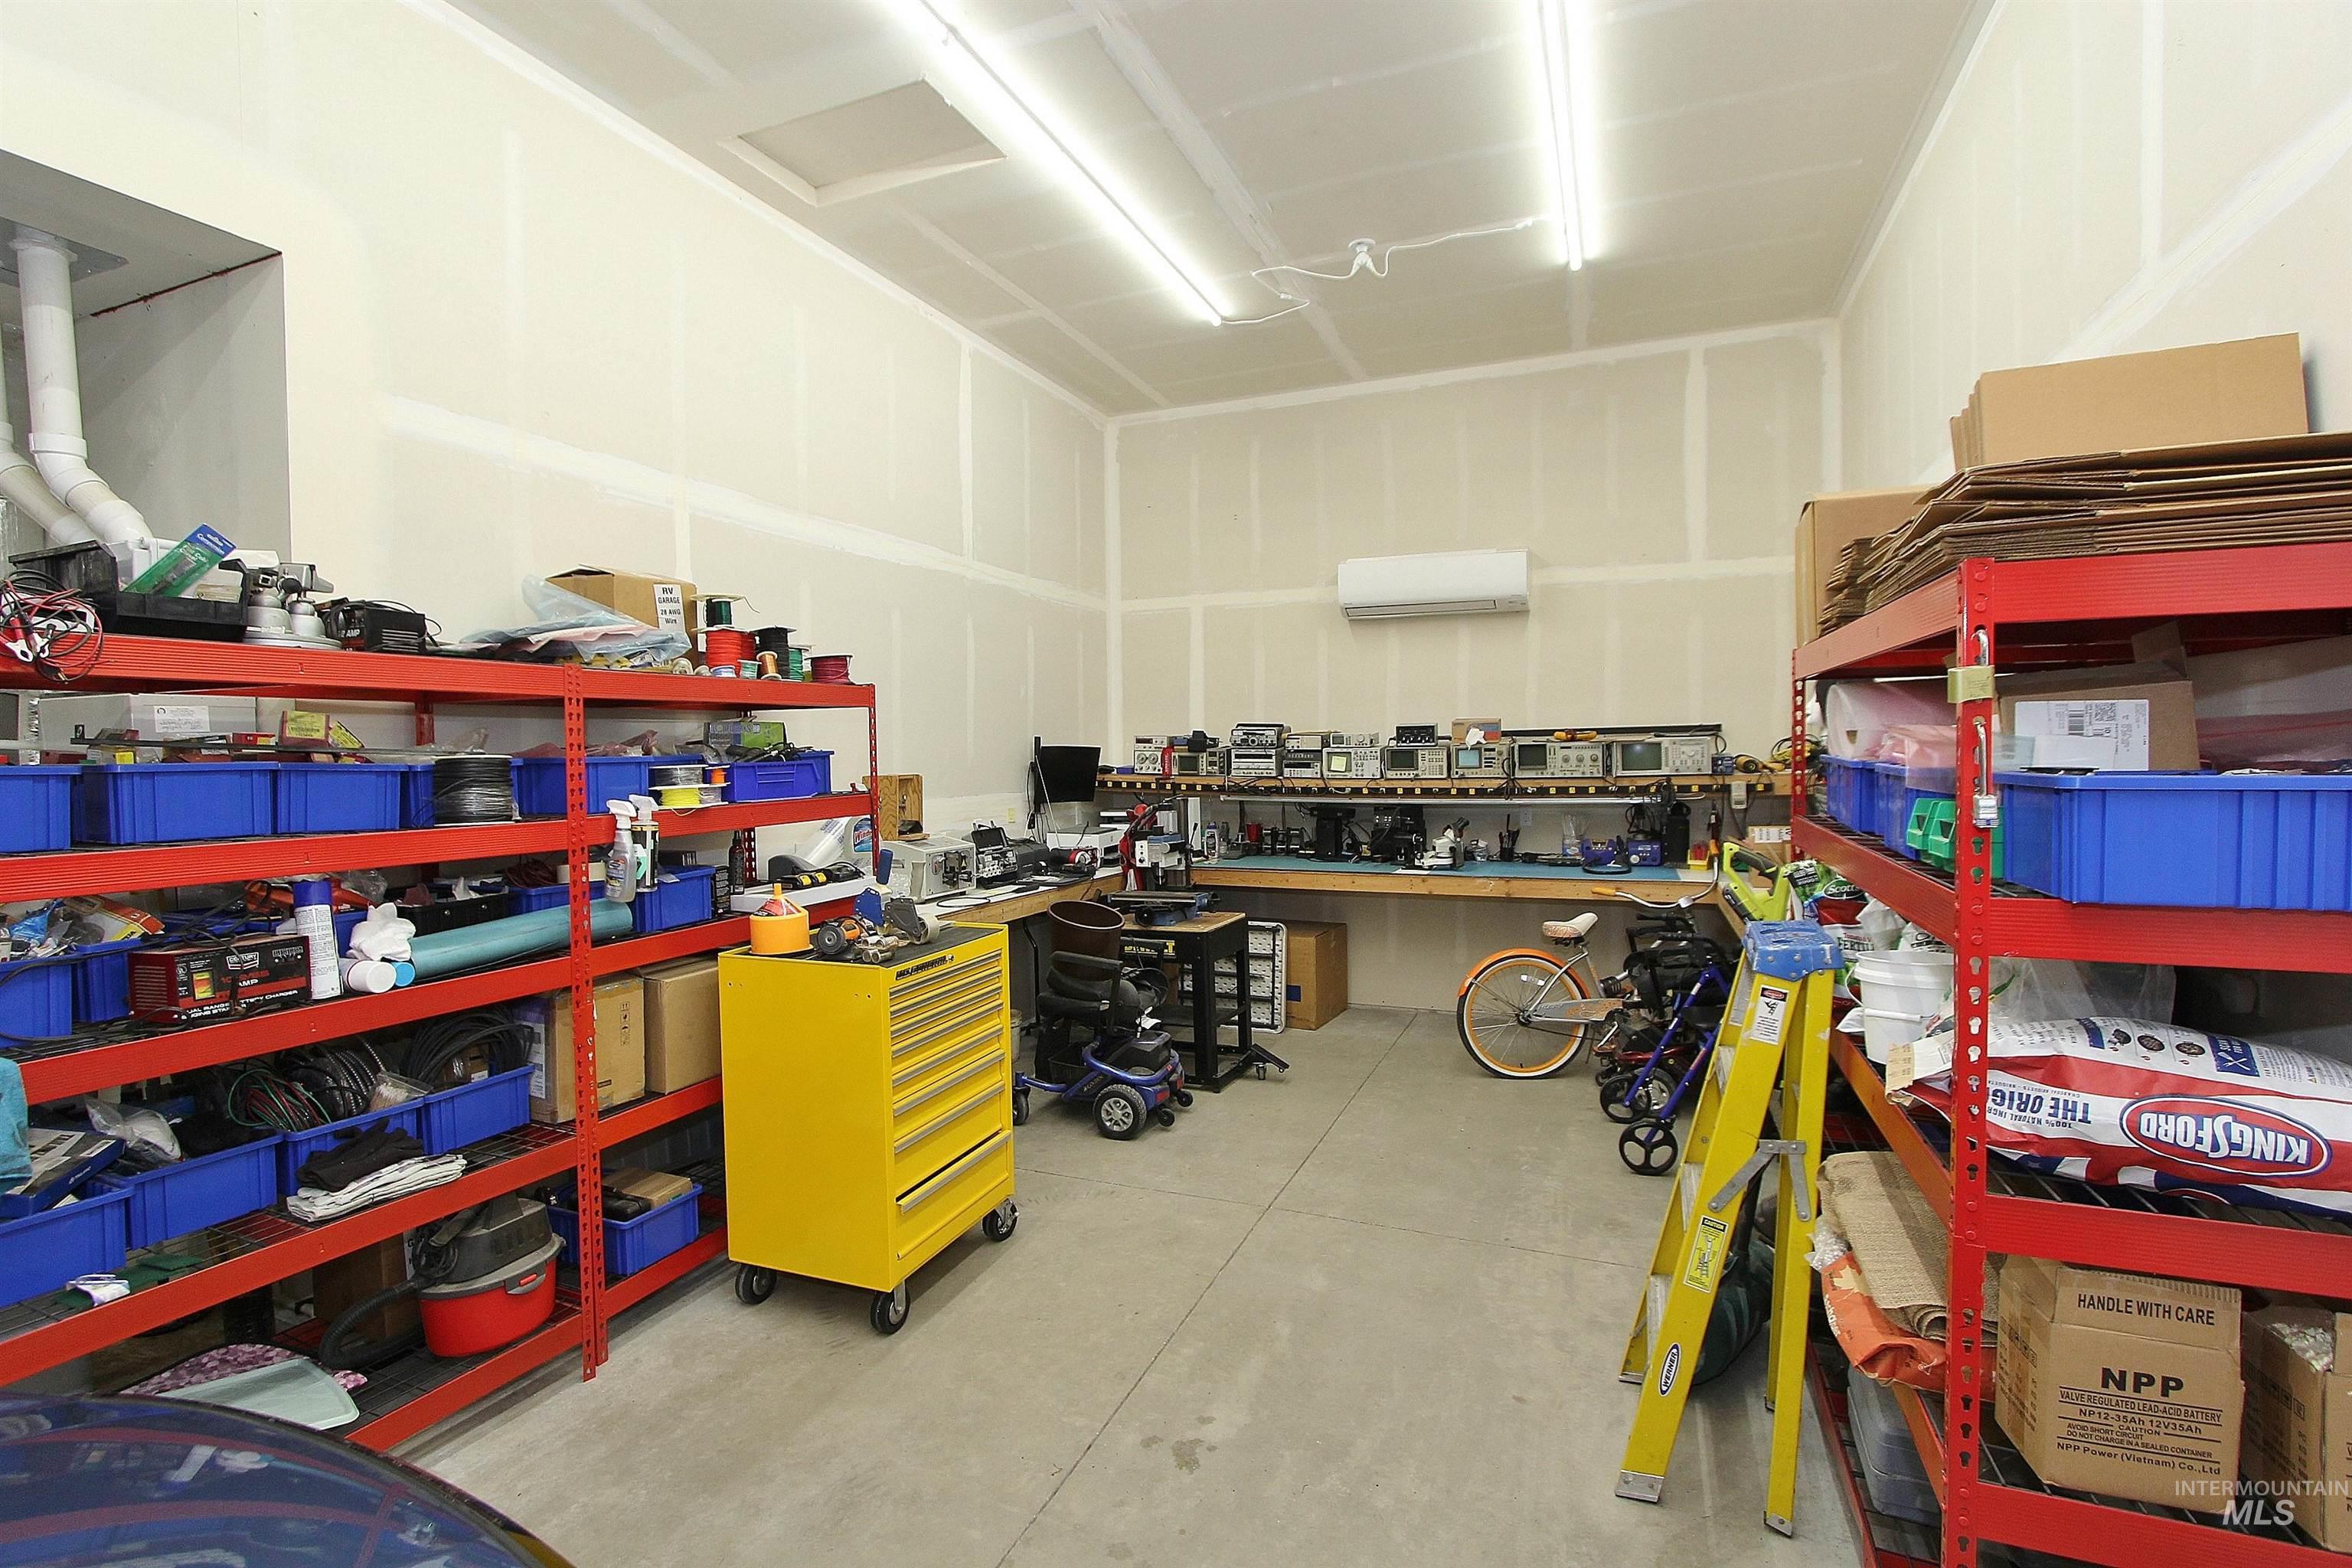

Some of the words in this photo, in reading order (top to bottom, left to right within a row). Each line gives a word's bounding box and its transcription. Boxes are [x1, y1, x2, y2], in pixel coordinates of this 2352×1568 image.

[662, 586, 673, 595] RV
[345, 629, 361, 637] AMP
[266, 990, 299, 1000] CHARGER
[2010, 1113, 2043, 1125] NATURAL
[2045, 1119, 2073, 1129] 100%
[2047, 1096, 2092, 1125] THE
[2140, 1112, 2310, 1165] KINGSFORD
[2077, 1292, 2134, 1315] HANDLE
[2136, 1300, 2172, 1320] WITH
[2175, 1305, 2216, 1326] CARE
[1662, 1351, 1678, 1387] WERNER
[2100, 1367, 2184, 1398] NPP
[2060, 1390, 2086, 1403] VALVE
[2086, 1393, 2135, 1412] REGULATED
[2137, 1402, 2183, 1417] LEAD-ACID
[2183, 1410, 2222, 1423] BATTERY
[2066, 1422, 2089, 1432] AVOID
[2089, 1426, 2115, 1436] SHORT
[2115, 1429, 2145, 1441] CIRCUIT
[2079, 1407, 2145, 1426] NP12-35Ah
[2148, 1419, 2203, 1435] 12V35Ah
[2118, 1424, 2161, 1436] CAUTION
[2066, 1429, 2078, 1438] DO
[2078, 1431, 2094, 1441] NOT
[2094, 1434, 2125, 1446] CHARGE
[2125, 1438, 2134, 1447] IN
[2134, 1439, 2140, 1448] A
[2140, 1440, 2170, 1453] SEALED
[2170, 1446, 2213, 1459] CONTAINER
[2056, 1441, 2081, 1453] NPP
[2082, 1446, 2118, 1459] Power
[2120, 1452, 2176, 1470] (Vietnam)
[2178, 1461, 2221, 1476] Co.,Ltd
